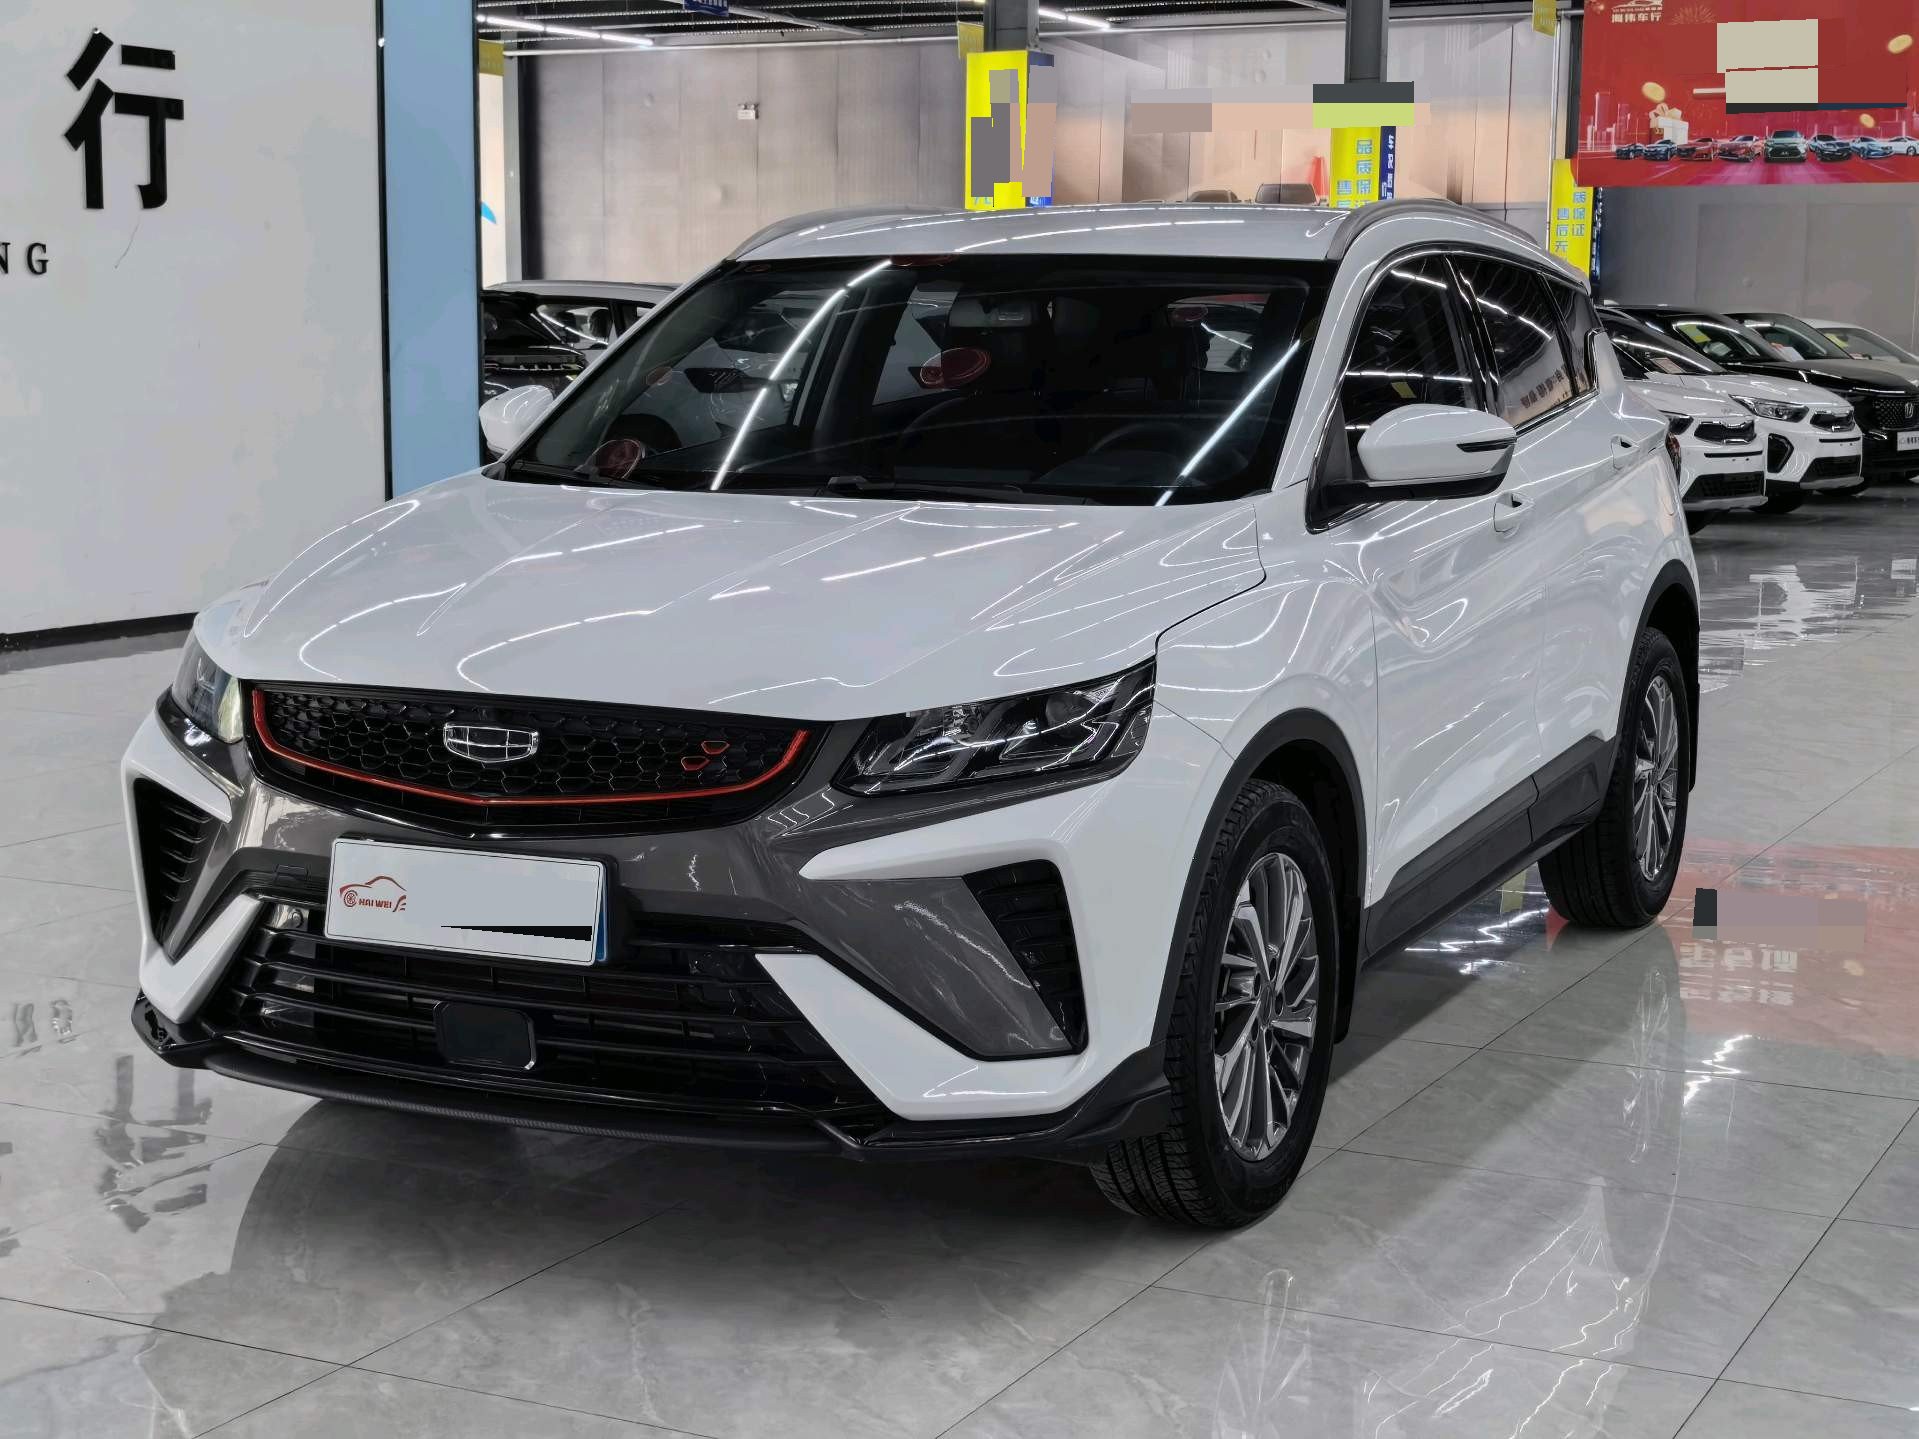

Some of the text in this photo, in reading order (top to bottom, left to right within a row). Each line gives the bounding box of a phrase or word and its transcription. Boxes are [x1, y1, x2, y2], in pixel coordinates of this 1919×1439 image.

[64, 28, 184, 209] 行
[358, 898, 392, 908] HAI WEI
